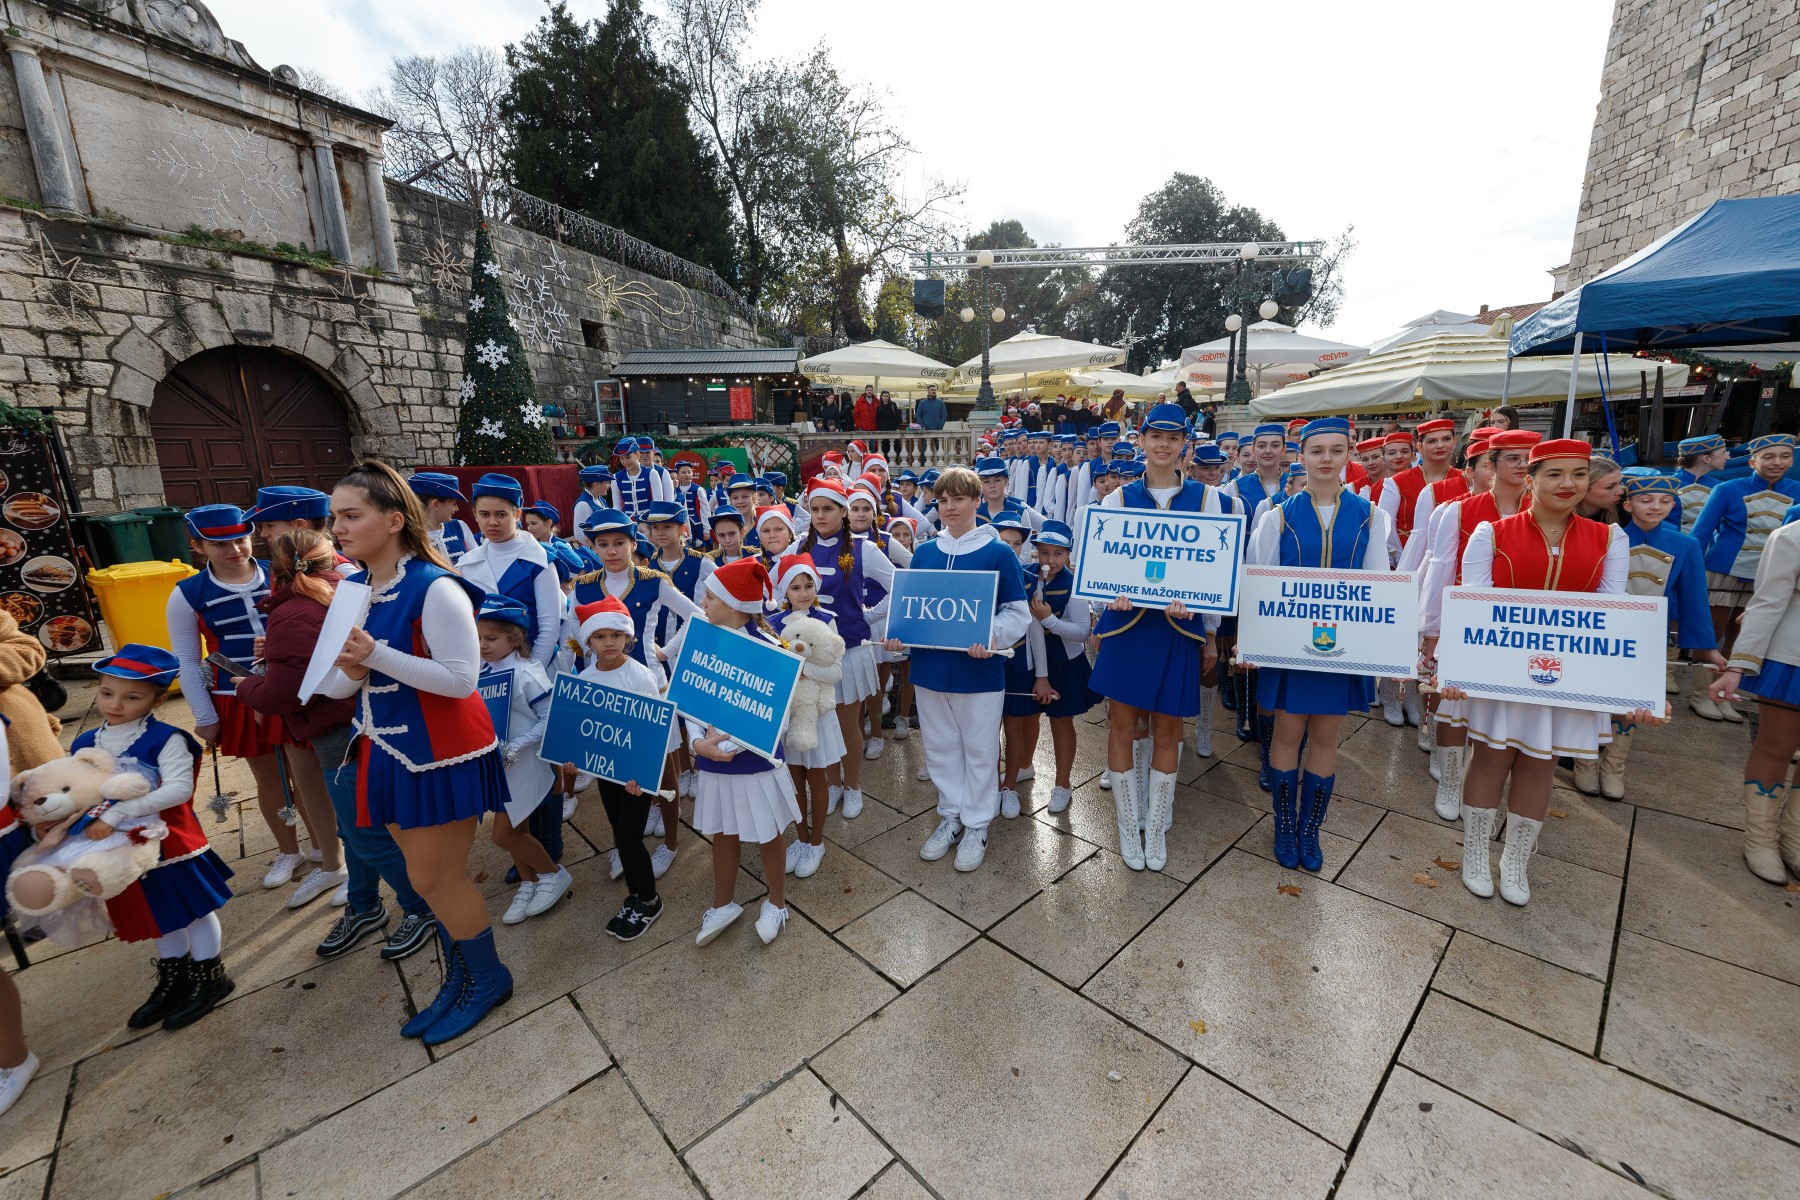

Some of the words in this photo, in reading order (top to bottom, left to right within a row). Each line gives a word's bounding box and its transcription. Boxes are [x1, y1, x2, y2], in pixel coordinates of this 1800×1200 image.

[1199, 352, 1226, 361] CEDEVITA
[1318, 351, 1349, 362] CEDEVITA
[1122, 520, 1201, 543] LIVNO
[1103, 540, 1216, 563] MAJORETTES
[1086, 580, 1139, 595] LIVANJSKE
[1141, 586, 1222, 604] MAŽORETKINJE
[1281, 581, 1372, 602] LJUBUŠKE
[901, 595, 981, 623] TKON
[1258, 599, 1396, 625] MAŽORETKINJE
[1492, 605, 1607, 630] NEUMSKE
[1463, 626, 1637, 659] MAŽORETKINJE
[691, 649, 776, 697] MAŽORETKINJE
[480, 682, 508, 700] TKINJE
[558, 680, 670, 727] MAŽORETKINJE
[681, 669, 717, 697] OTOKA
[717, 685, 773, 723] PAŠMANA
[580, 719, 632, 750] OTOKA
[585, 751, 615, 778] VIRA
